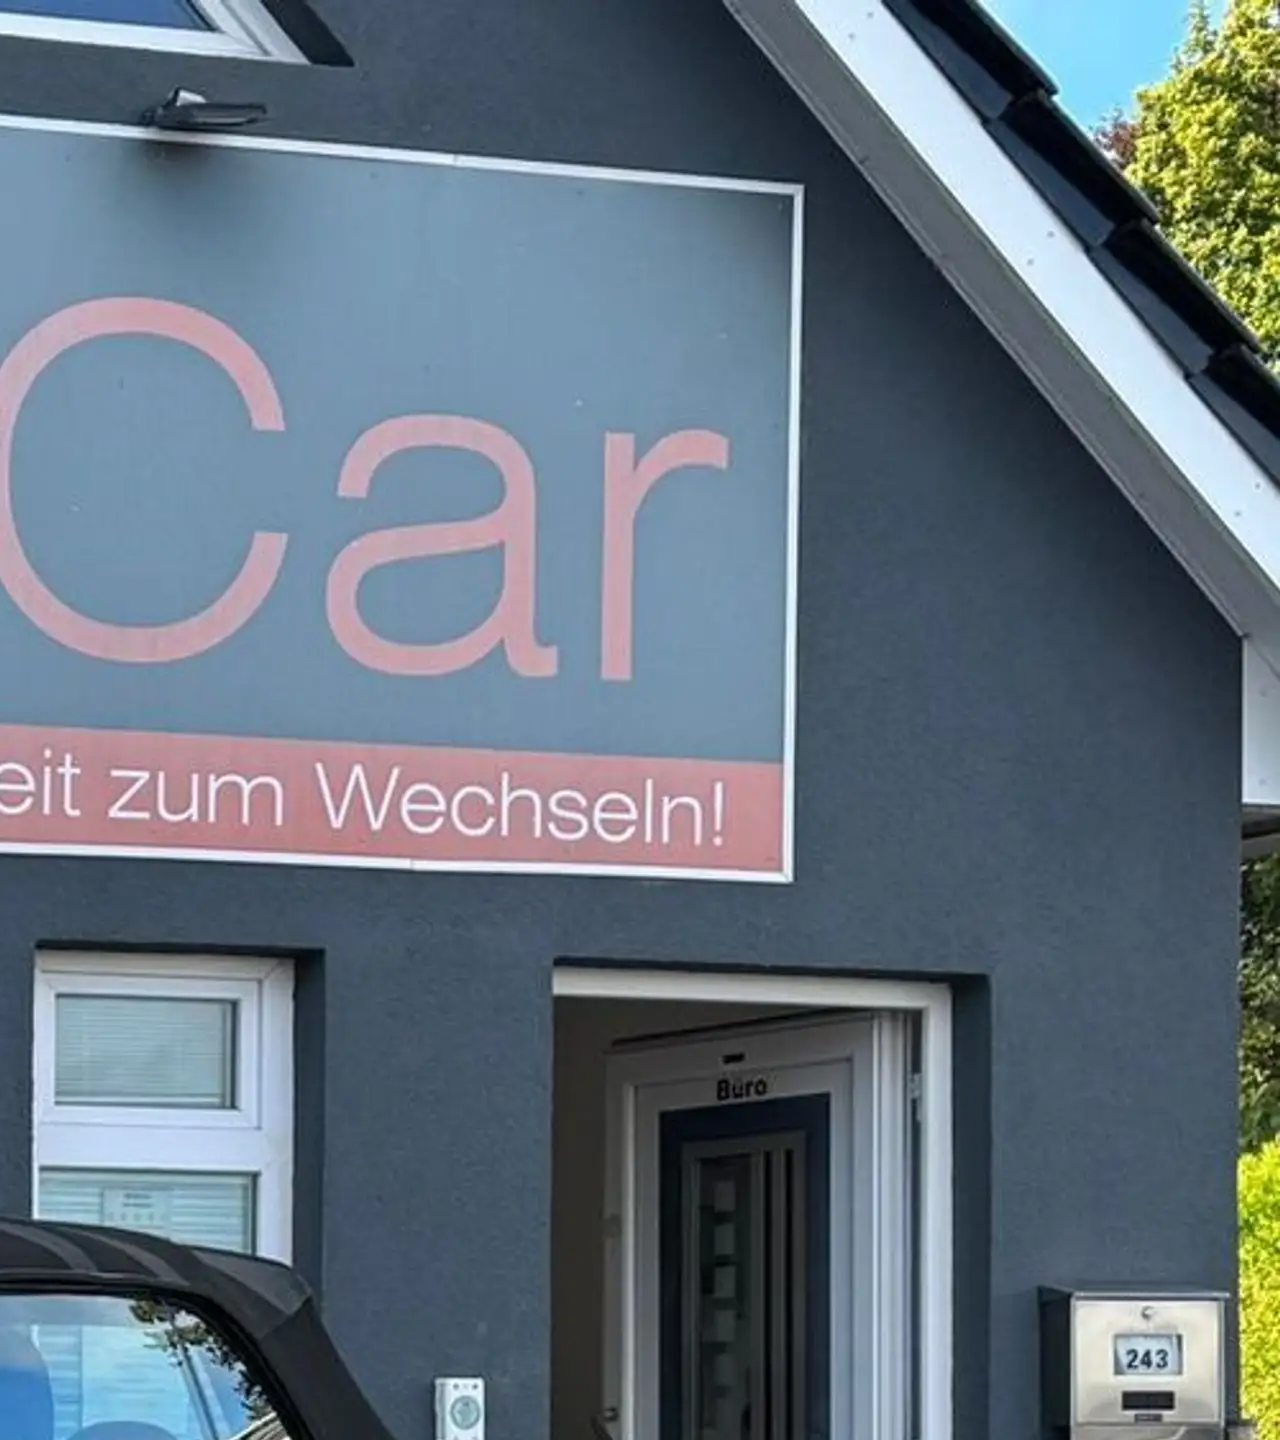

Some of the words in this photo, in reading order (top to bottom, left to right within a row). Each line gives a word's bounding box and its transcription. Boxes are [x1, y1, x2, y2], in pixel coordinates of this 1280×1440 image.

[108, 768, 284, 827] zum
[316, 762, 724, 847] Wechseln!
[1126, 1348, 1169, 1370] 243
